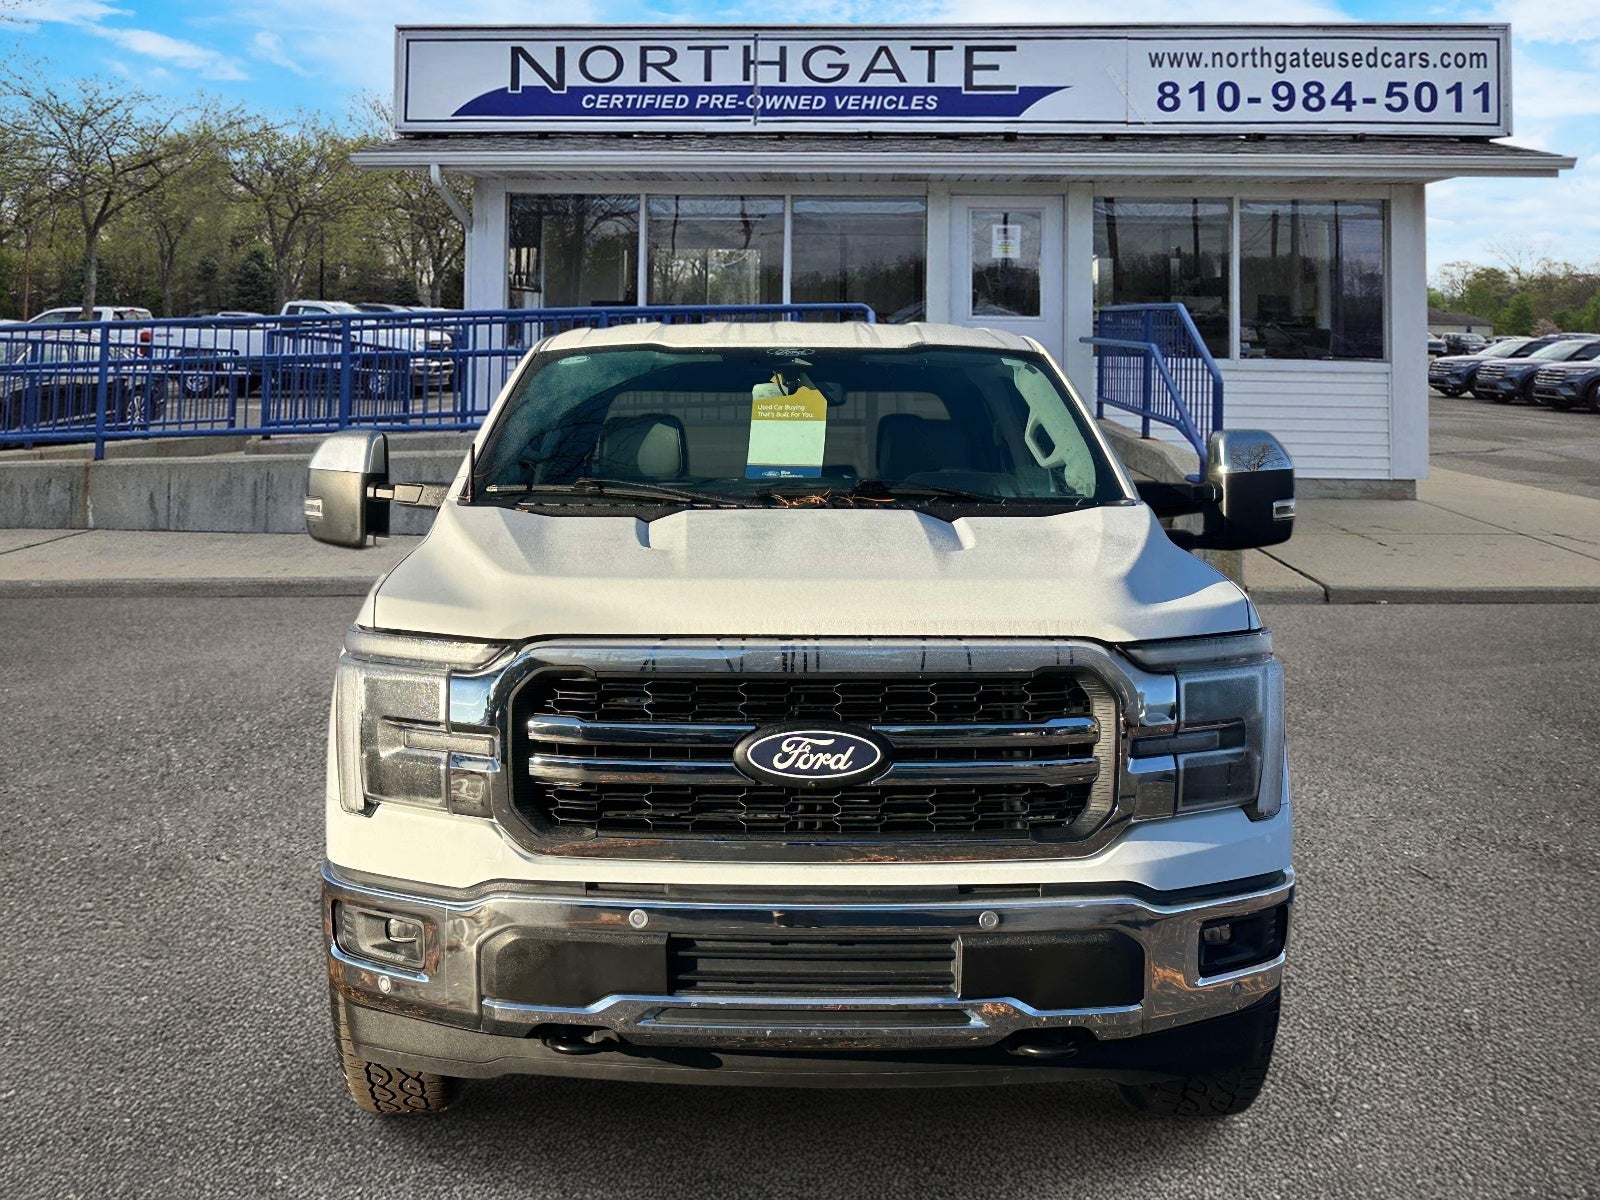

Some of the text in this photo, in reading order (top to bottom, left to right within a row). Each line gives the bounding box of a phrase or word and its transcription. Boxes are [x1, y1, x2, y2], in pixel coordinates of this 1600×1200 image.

[510, 45, 1017, 91] NORTHGATE
[1149, 46, 1488, 73] www.northgateusedcars.com
[581, 94, 939, 110] CERTIFIED PRE-OWNED VEHICLES
[1156, 80, 1491, 113] 810-984-5011
[784, 404, 806, 412] Buying
[772, 736, 856, 770] Ford
